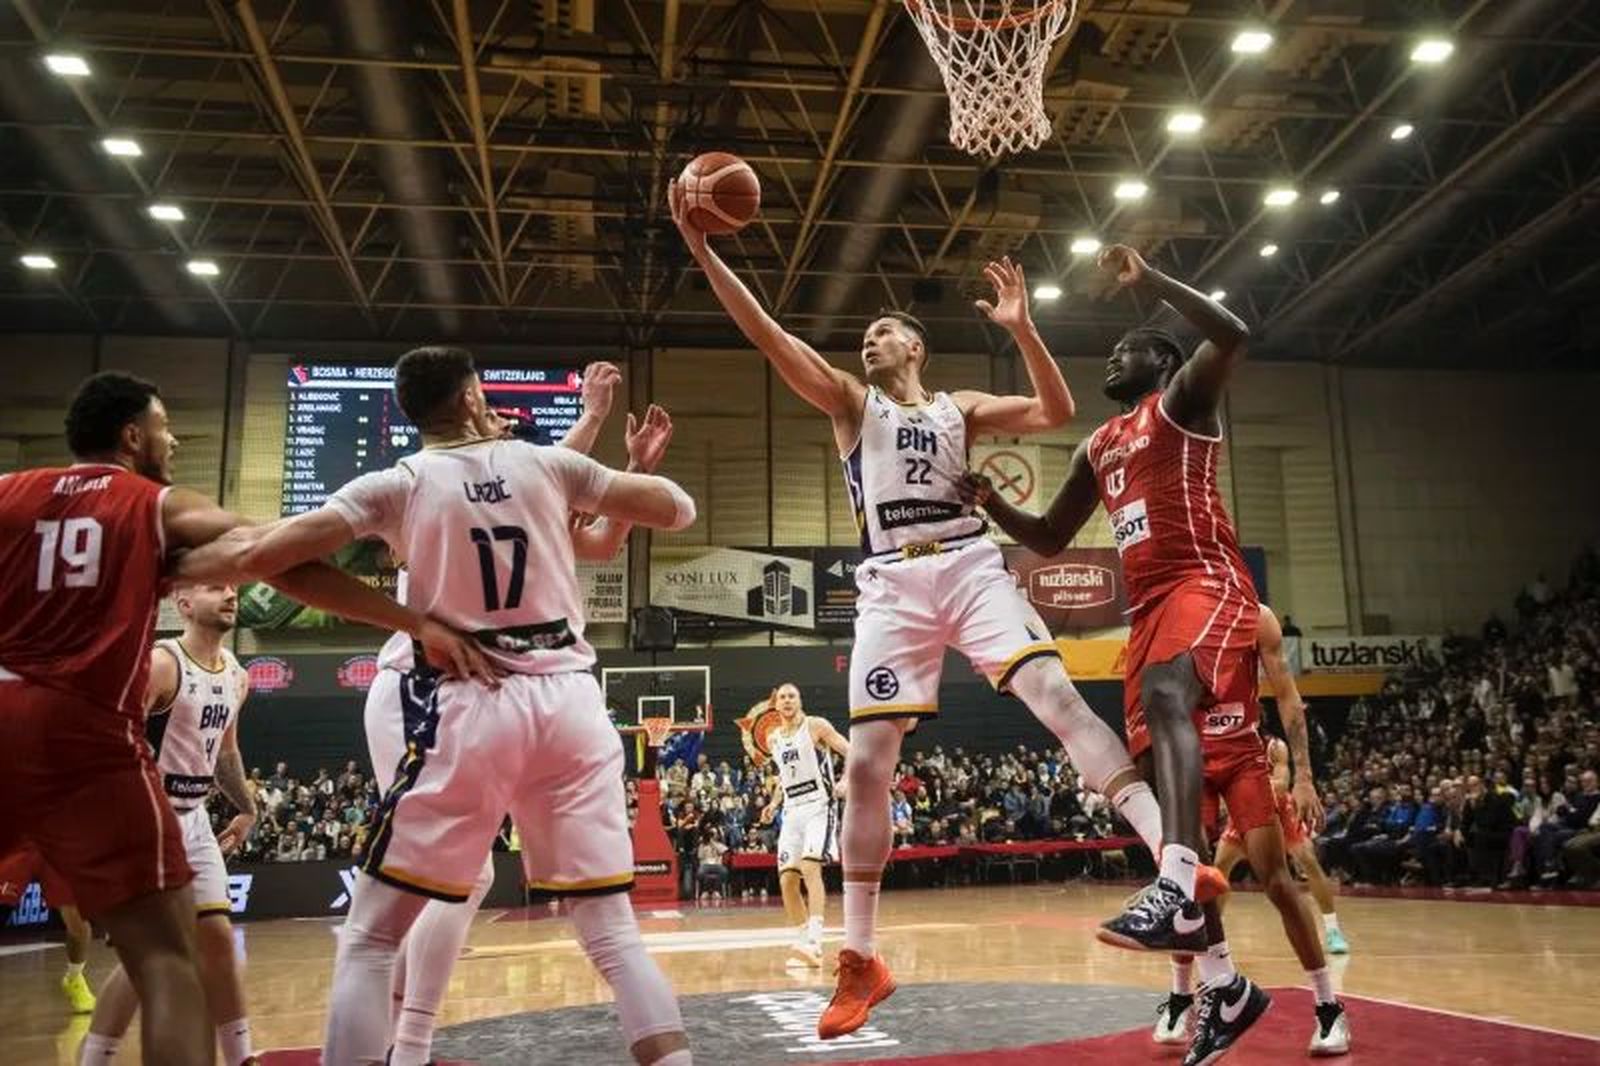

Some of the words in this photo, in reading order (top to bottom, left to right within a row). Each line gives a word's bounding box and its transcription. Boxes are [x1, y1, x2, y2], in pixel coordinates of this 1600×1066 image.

[312, 366, 347, 377] BOSNIA
[354, 367, 397, 378] HERZEGO
[483, 370, 546, 381] SWITZERLAND
[896, 427, 938, 456] BIH
[905, 459, 932, 484] 22
[883, 504, 951, 522] telema
[34, 517, 103, 591] 19
[470, 525, 528, 612] 17
[1039, 568, 1104, 587] tuzlanski
[1053, 591, 1092, 604] pilsner
[1312, 641, 1427, 666] tuzlanski
[200, 703, 230, 730] BIH
[1207, 715, 1242, 727] SOT
